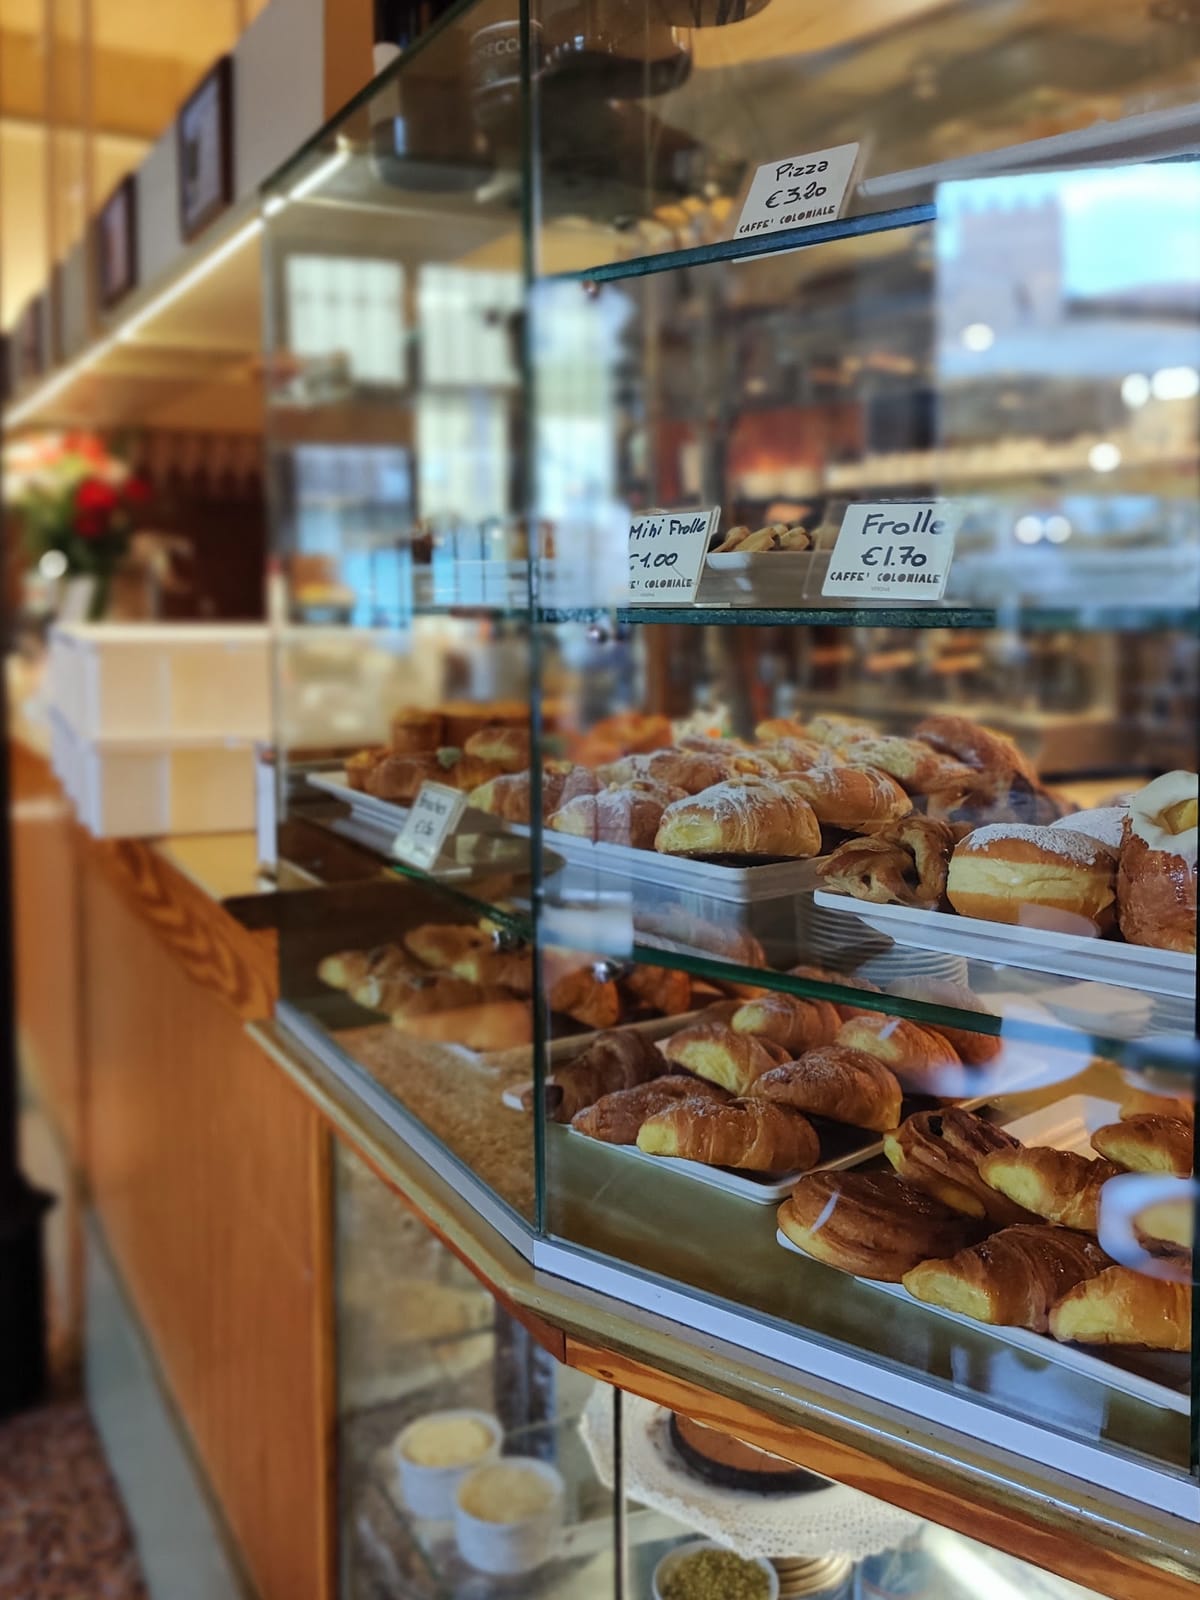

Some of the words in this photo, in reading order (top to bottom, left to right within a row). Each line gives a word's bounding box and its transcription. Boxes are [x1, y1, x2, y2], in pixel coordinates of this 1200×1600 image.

[776, 161, 829, 181] Pizza
[780, 205, 835, 224] COLONIALE
[669, 517, 706, 536] Frolle
[862, 509, 945, 534] Frolle
[860, 545, 928, 567] €1.70
[644, 578, 693, 589] COLONIALE
[876, 572, 942, 584] COLONIALE
